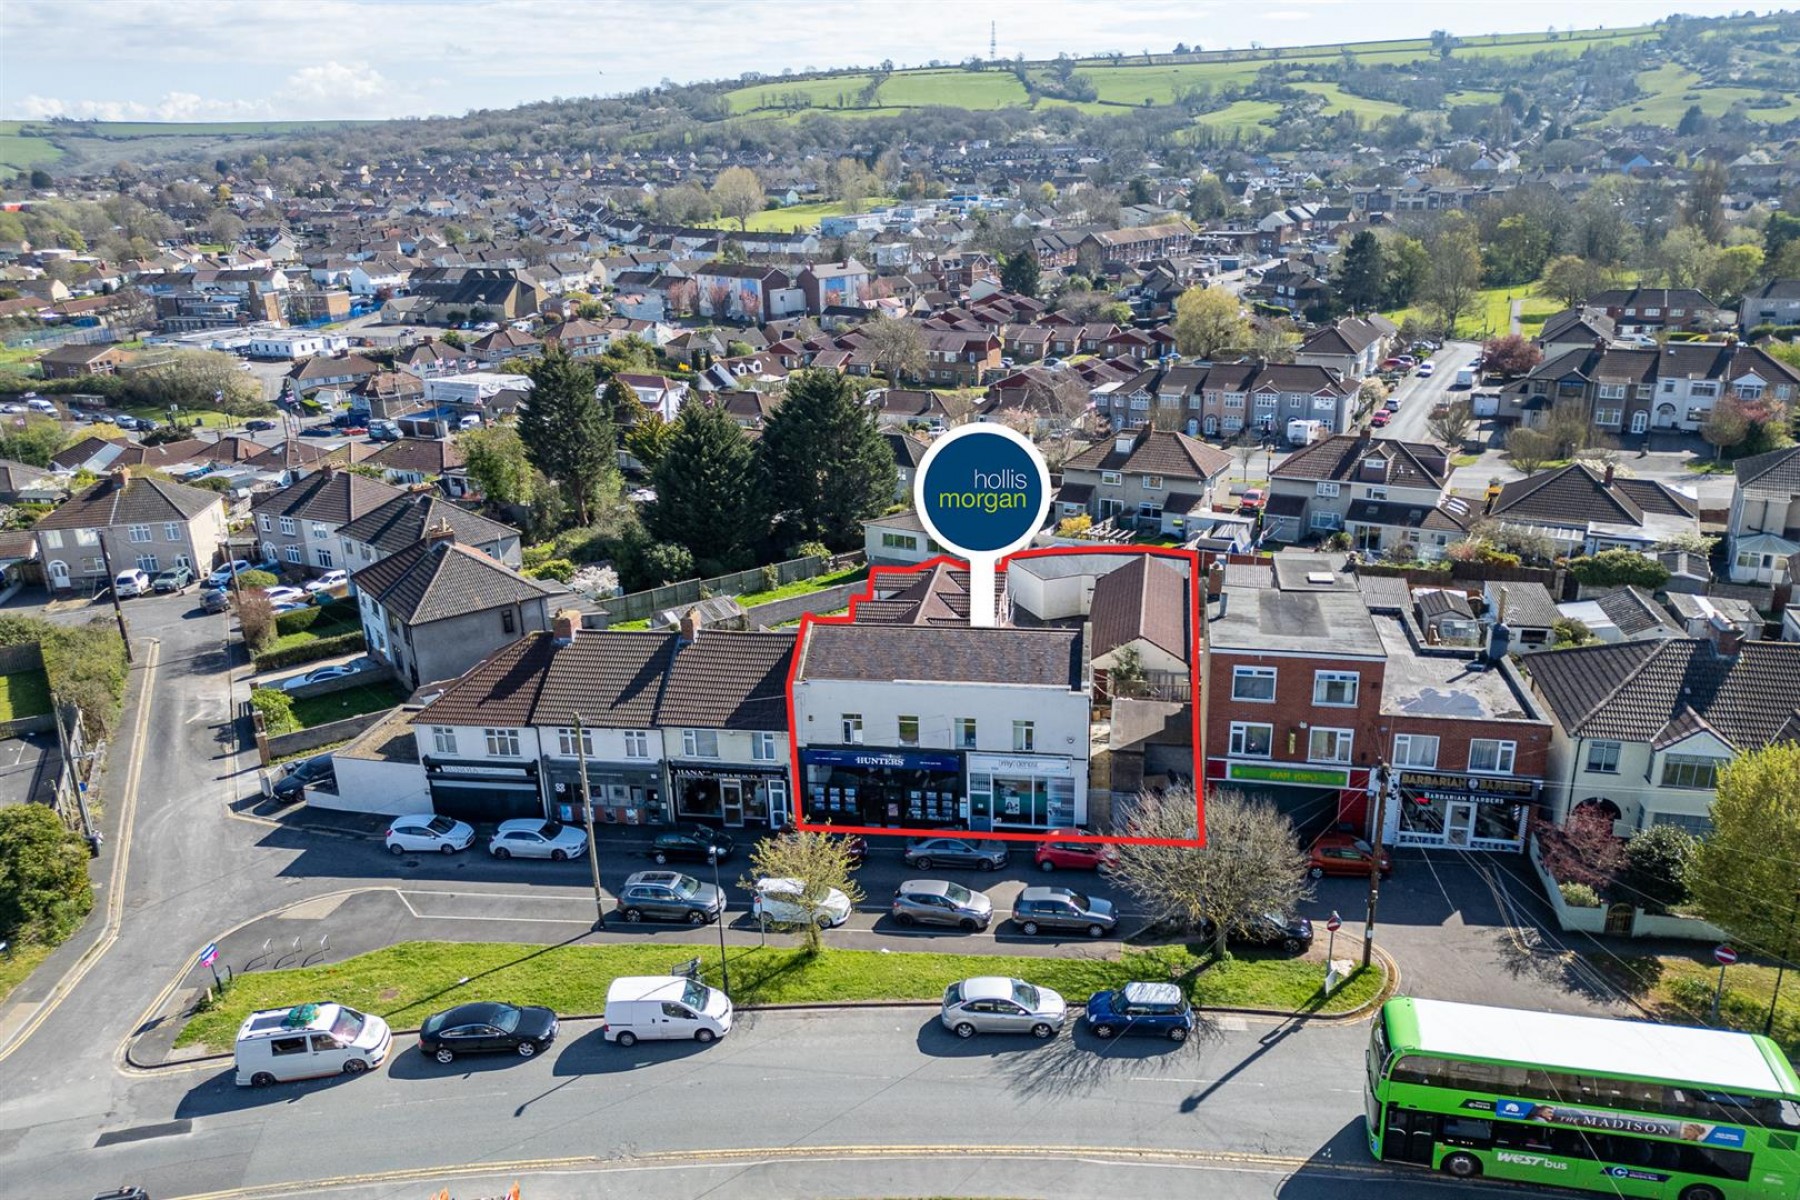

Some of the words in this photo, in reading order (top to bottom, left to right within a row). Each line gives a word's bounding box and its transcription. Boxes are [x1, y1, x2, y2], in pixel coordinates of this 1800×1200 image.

[855, 756, 905, 766] HUNTERS
[1401, 773, 1467, 788] BARBARIAN
[1479, 780, 1531, 792] BARBERS
[1424, 792, 1467, 801] BARBARIAN
[1469, 795, 1504, 804] BARBERS
[1583, 1116, 1671, 1135] MADISON
[1545, 1158, 1567, 1170] bus
